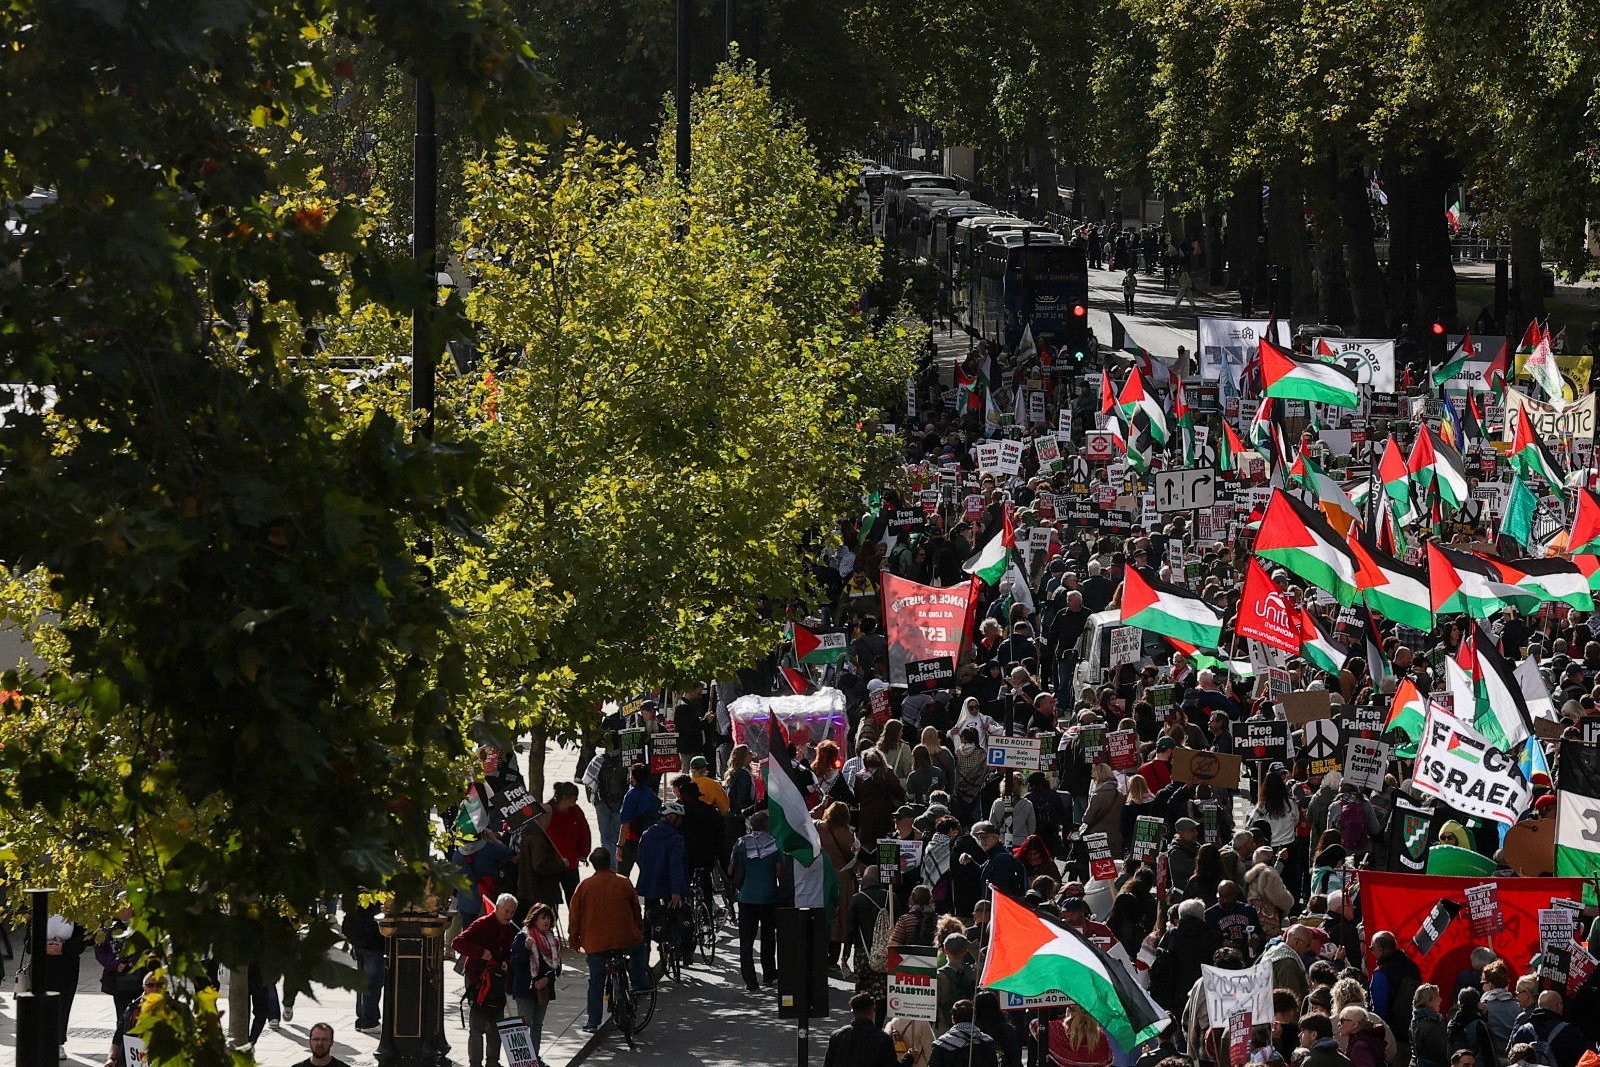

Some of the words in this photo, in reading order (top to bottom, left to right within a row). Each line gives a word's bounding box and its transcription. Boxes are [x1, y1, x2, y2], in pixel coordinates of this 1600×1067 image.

[896, 510, 907, 519] Free
[1068, 510, 1099, 519] Palestine
[1107, 511, 1123, 520] Free
[888, 516, 923, 527] Palestine
[1098, 518, 1130, 528] Palestine
[1264, 621, 1294, 638] theUNION
[1130, 642, 1139, 650] WHO
[1120, 653, 1130, 662] DIES
[918, 661, 940, 672] Free
[908, 669, 952, 683] Palestine
[1356, 708, 1380, 719] Free
[1248, 725, 1272, 735] Free
[654, 738, 678, 746] FREEDOM
[1234, 736, 1285, 748] Palestine
[652, 747, 678, 755] PALESTINE
[1354, 745, 1382, 756] Stop
[992, 750, 1003, 763] P
[1351, 754, 1382, 767] Arming
[1312, 761, 1327, 769] END
[1312, 764, 1342, 774] GENOCIDE
[1351, 764, 1379, 775] Israel
[1422, 755, 1520, 818] ISRAEL
[506, 786, 525, 801] Free
[1087, 840, 1108, 850] FREEDOM
[1135, 841, 1157, 849] PALESTINE
[1088, 850, 1112, 860] PALESTINE
[1480, 902, 1498, 912] AGAINST
[1472, 910, 1493, 920] GENOCIDE
[895, 973, 931, 986] FREE
[889, 986, 935, 996] PALESTINE
[1025, 996, 1043, 1005] max
[1045, 994, 1058, 1002] 40
